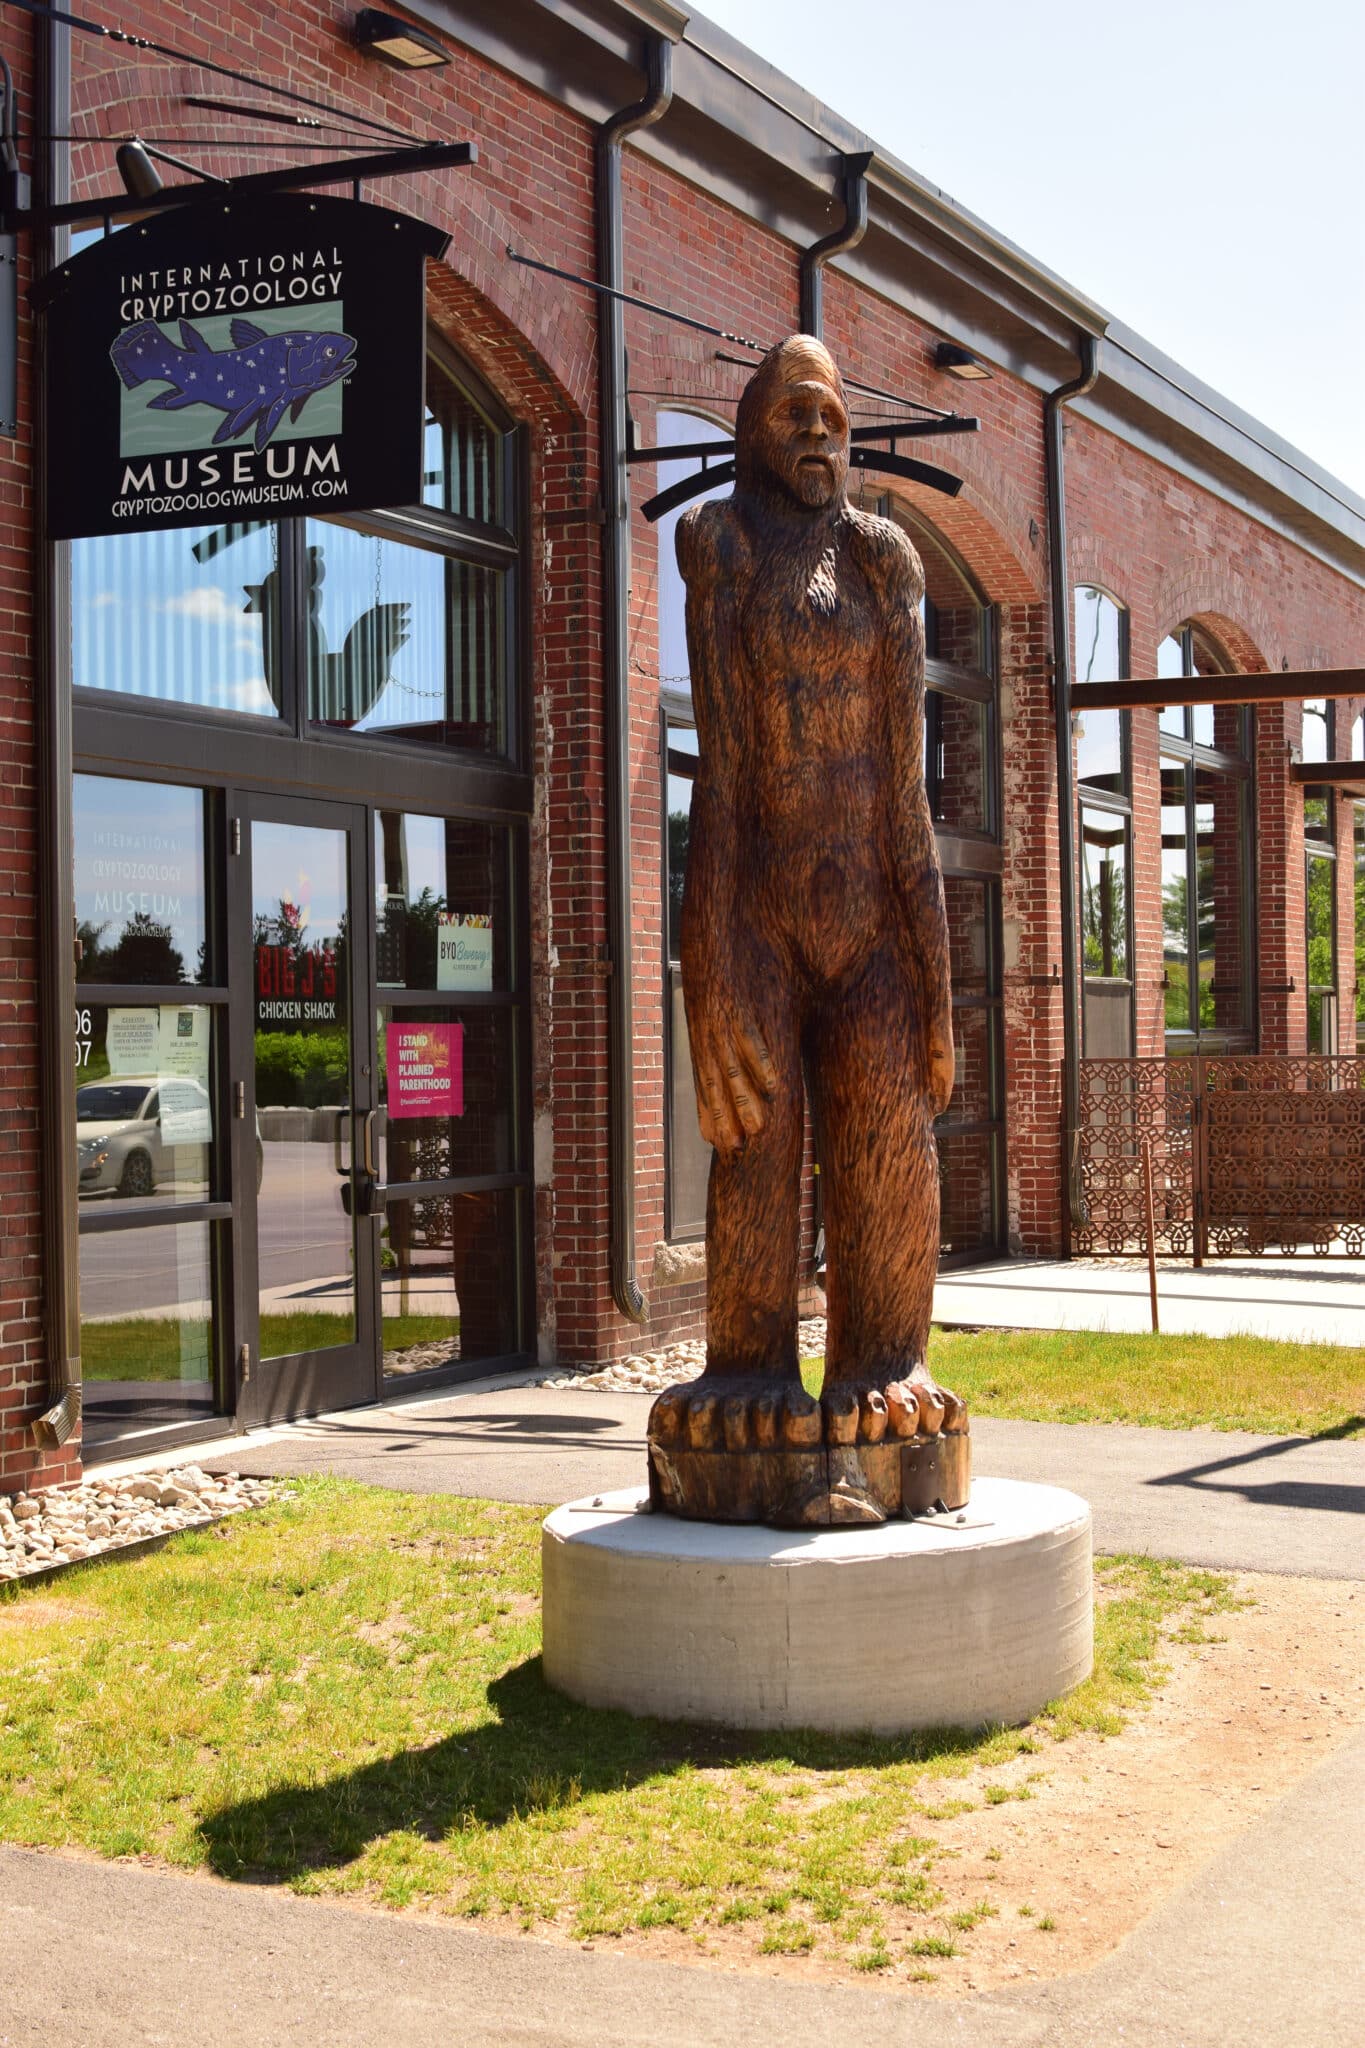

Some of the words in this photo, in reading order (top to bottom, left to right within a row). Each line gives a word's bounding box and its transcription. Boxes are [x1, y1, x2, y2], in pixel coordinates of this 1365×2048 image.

[120, 246, 343, 294] INTERNATIONAL
[120, 271, 343, 323] CRYPTOZOOLOGY
[120, 443, 341, 495] MUSEUM
[93, 860, 181, 881] CRYPTOZOOLOGY
[94, 889, 182, 916] MUSEUM
[440, 941, 456, 960] BYO
[258, 946, 295, 997] BIG
[259, 1001, 301, 1019] CHICKEN
[304, 1002, 336, 1019] SHACK
[398, 1035, 402, 1047] I
[403, 1034, 428, 1047] STAND
[399, 1050, 419, 1062] WITH
[399, 1064, 434, 1076] PLANNED
[399, 1078, 451, 1091] PARENTHOOD
